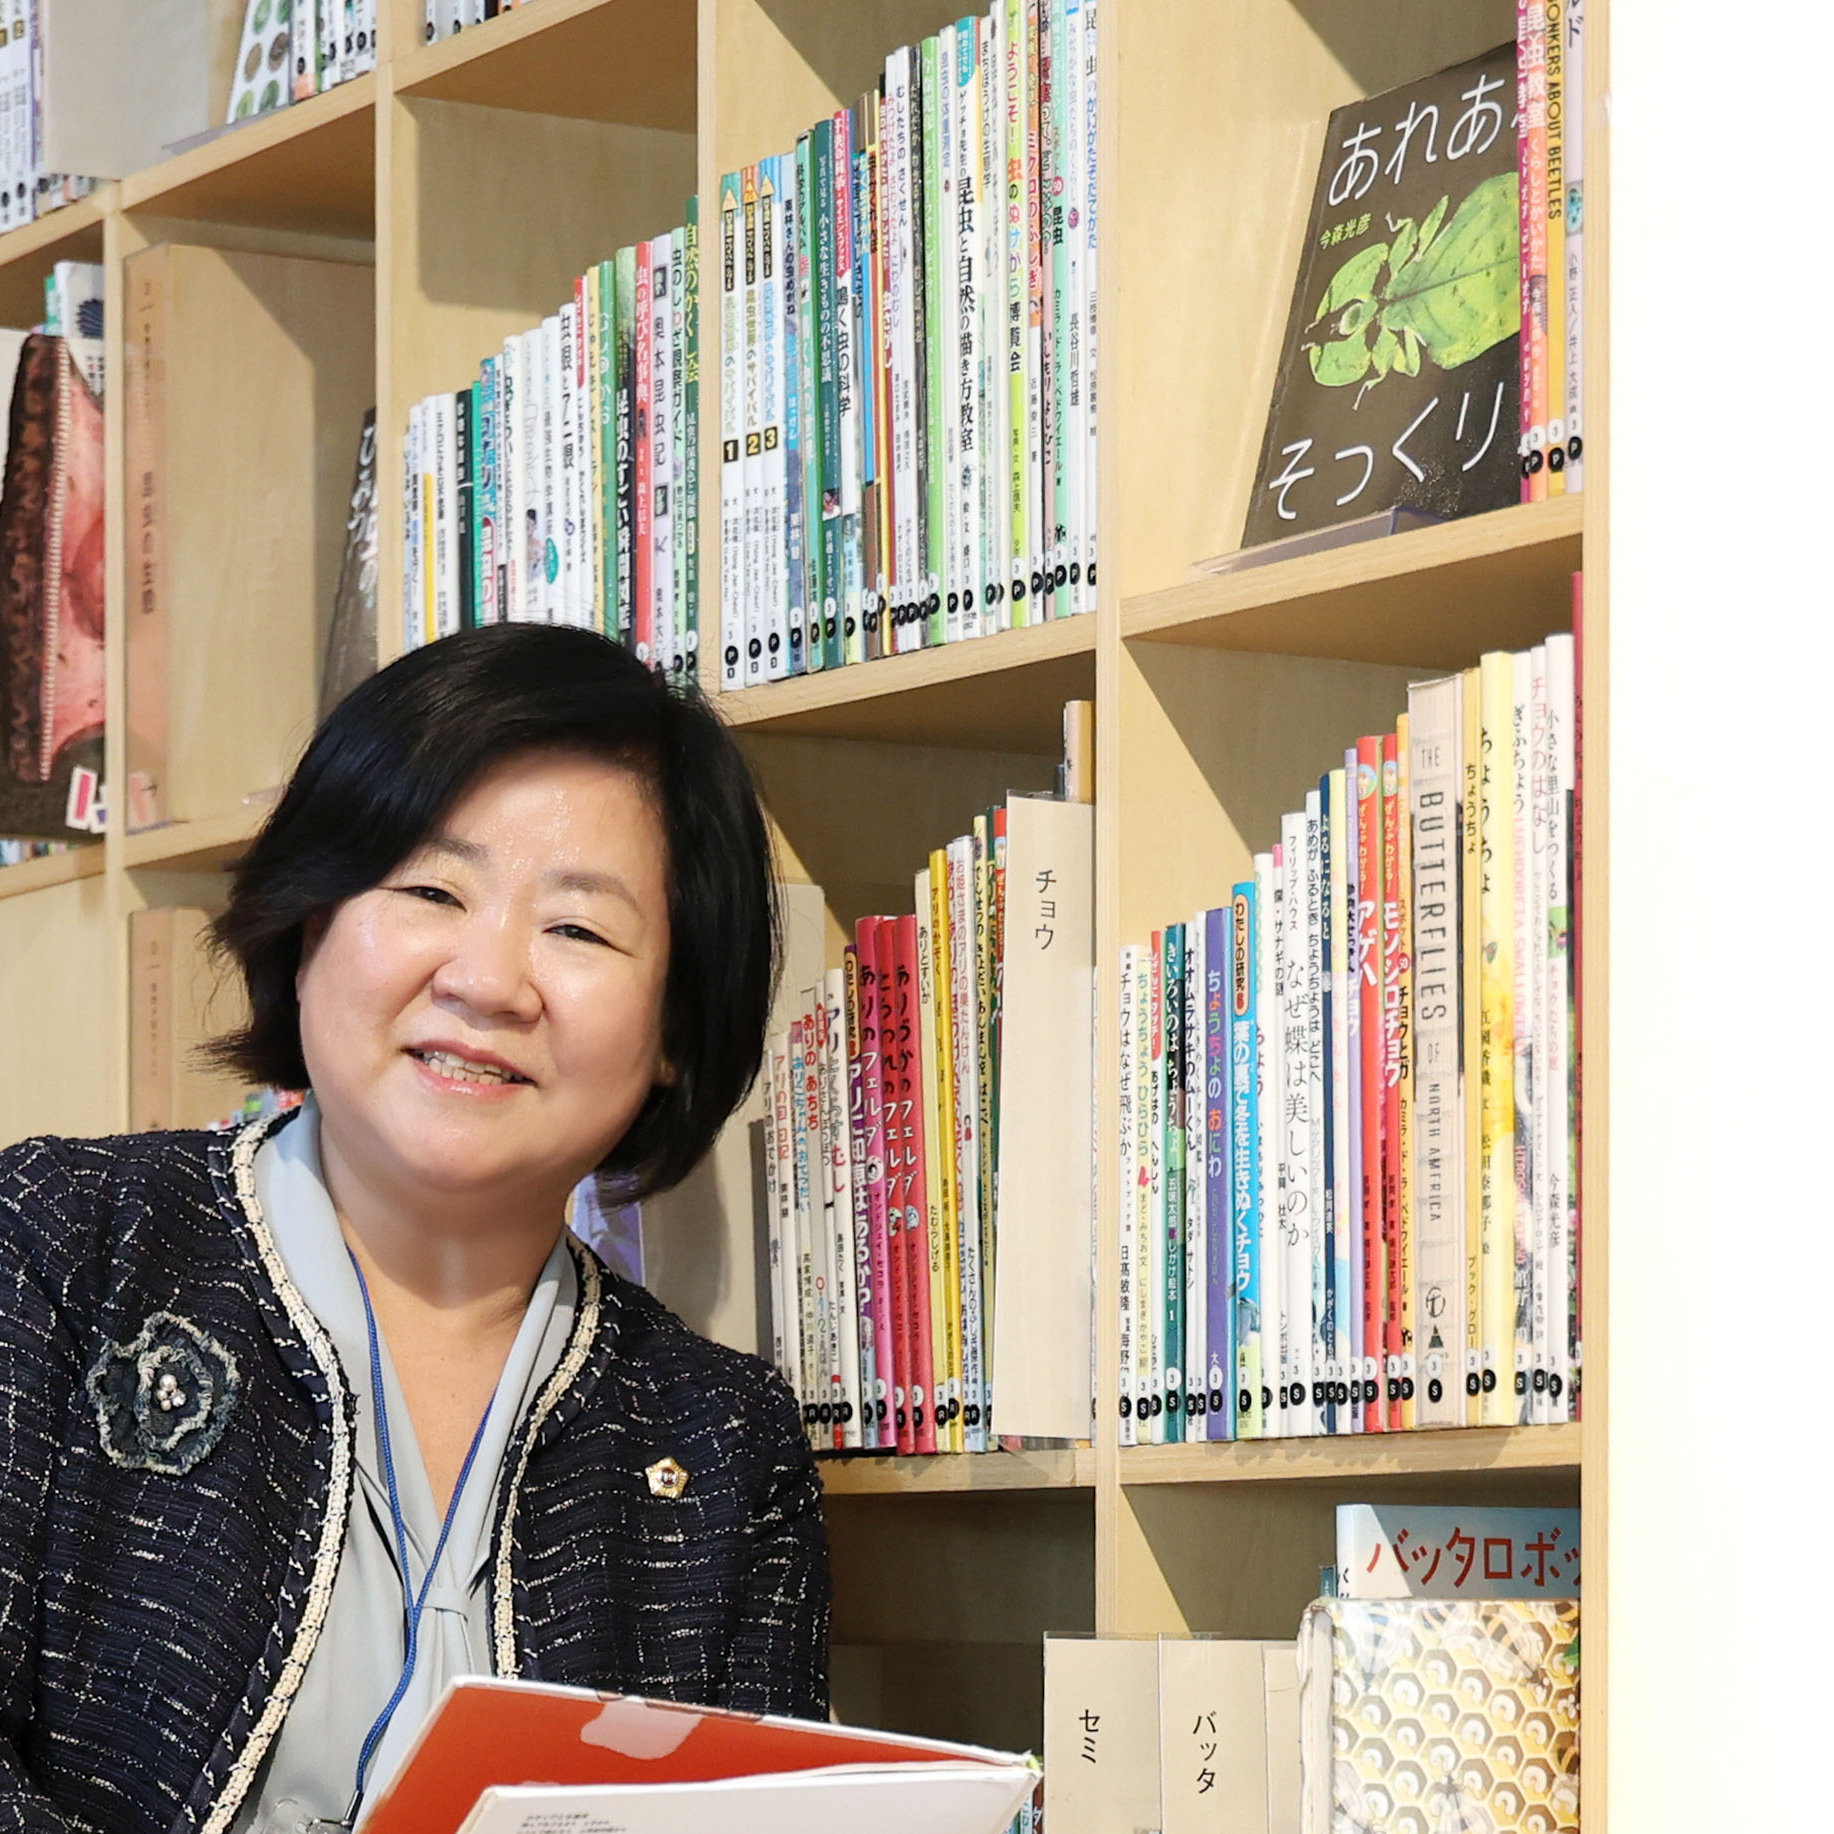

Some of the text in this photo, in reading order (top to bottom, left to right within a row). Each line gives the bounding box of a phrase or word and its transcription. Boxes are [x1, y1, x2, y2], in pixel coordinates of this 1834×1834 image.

[1328, 73, 1518, 207] あれあ
[1547, 0, 1562, 219] ONKERS ABOUT BEETLES
[1053, 205, 1063, 246] 昆虫
[1319, 212, 1372, 249] 今森光彦
[1069, 313, 1080, 406] 長谷川哲雄
[1465, 764, 1477, 854] ちょうちょ
[1481, 727, 1493, 893] ちょうちょ
[1513, 704, 1526, 814] ぎふちょう
[1532, 676, 1546, 853] チョウのはなし
[1547, 709, 1559, 900] 小さな里山をつくる
[1034, 867, 1057, 952] チョウ
[1288, 836, 1298, 930] フィリップ・ハウス
[1166, 943, 1178, 1050] きいろいのは
[1307, 819, 1321, 1082] あめが ふるとき ちょうちょうは どこへ
[1358, 902, 1377, 987] アゲハ
[1383, 902, 1402, 1088] モンシロチョウ
[1419, 747, 1447, 1222] THE BUTTERFLIES OF NORTH AMERICA
[803, 1014, 819, 1132] ありの あちち
[860, 965, 883, 1147] ありの フェルダ
[1119, 973, 1132, 1156] チョウはなぜ飛ぶか
[1137, 973, 1149, 1156] ちょうちょう ひらひら
[1184, 948, 1196, 1151] オオムラサキのムーくん
[1207, 969, 1222, 1178] ちょうちょの おにわ
[1399, 986, 1409, 1080] チョウとガ
[885, 1102, 903, 1199] フェルダ
[900, 1100, 918, 1196] フェルダ
[1151, 1071, 1159, 1125] あげはの
[1285, 960, 1310, 1247] なぜ蝶は美しいのか
[1187, 1218, 1194, 1242] タダ
[1077, 1708, 1100, 1765] セミ
[1192, 1713, 1217, 1795] バッタ
